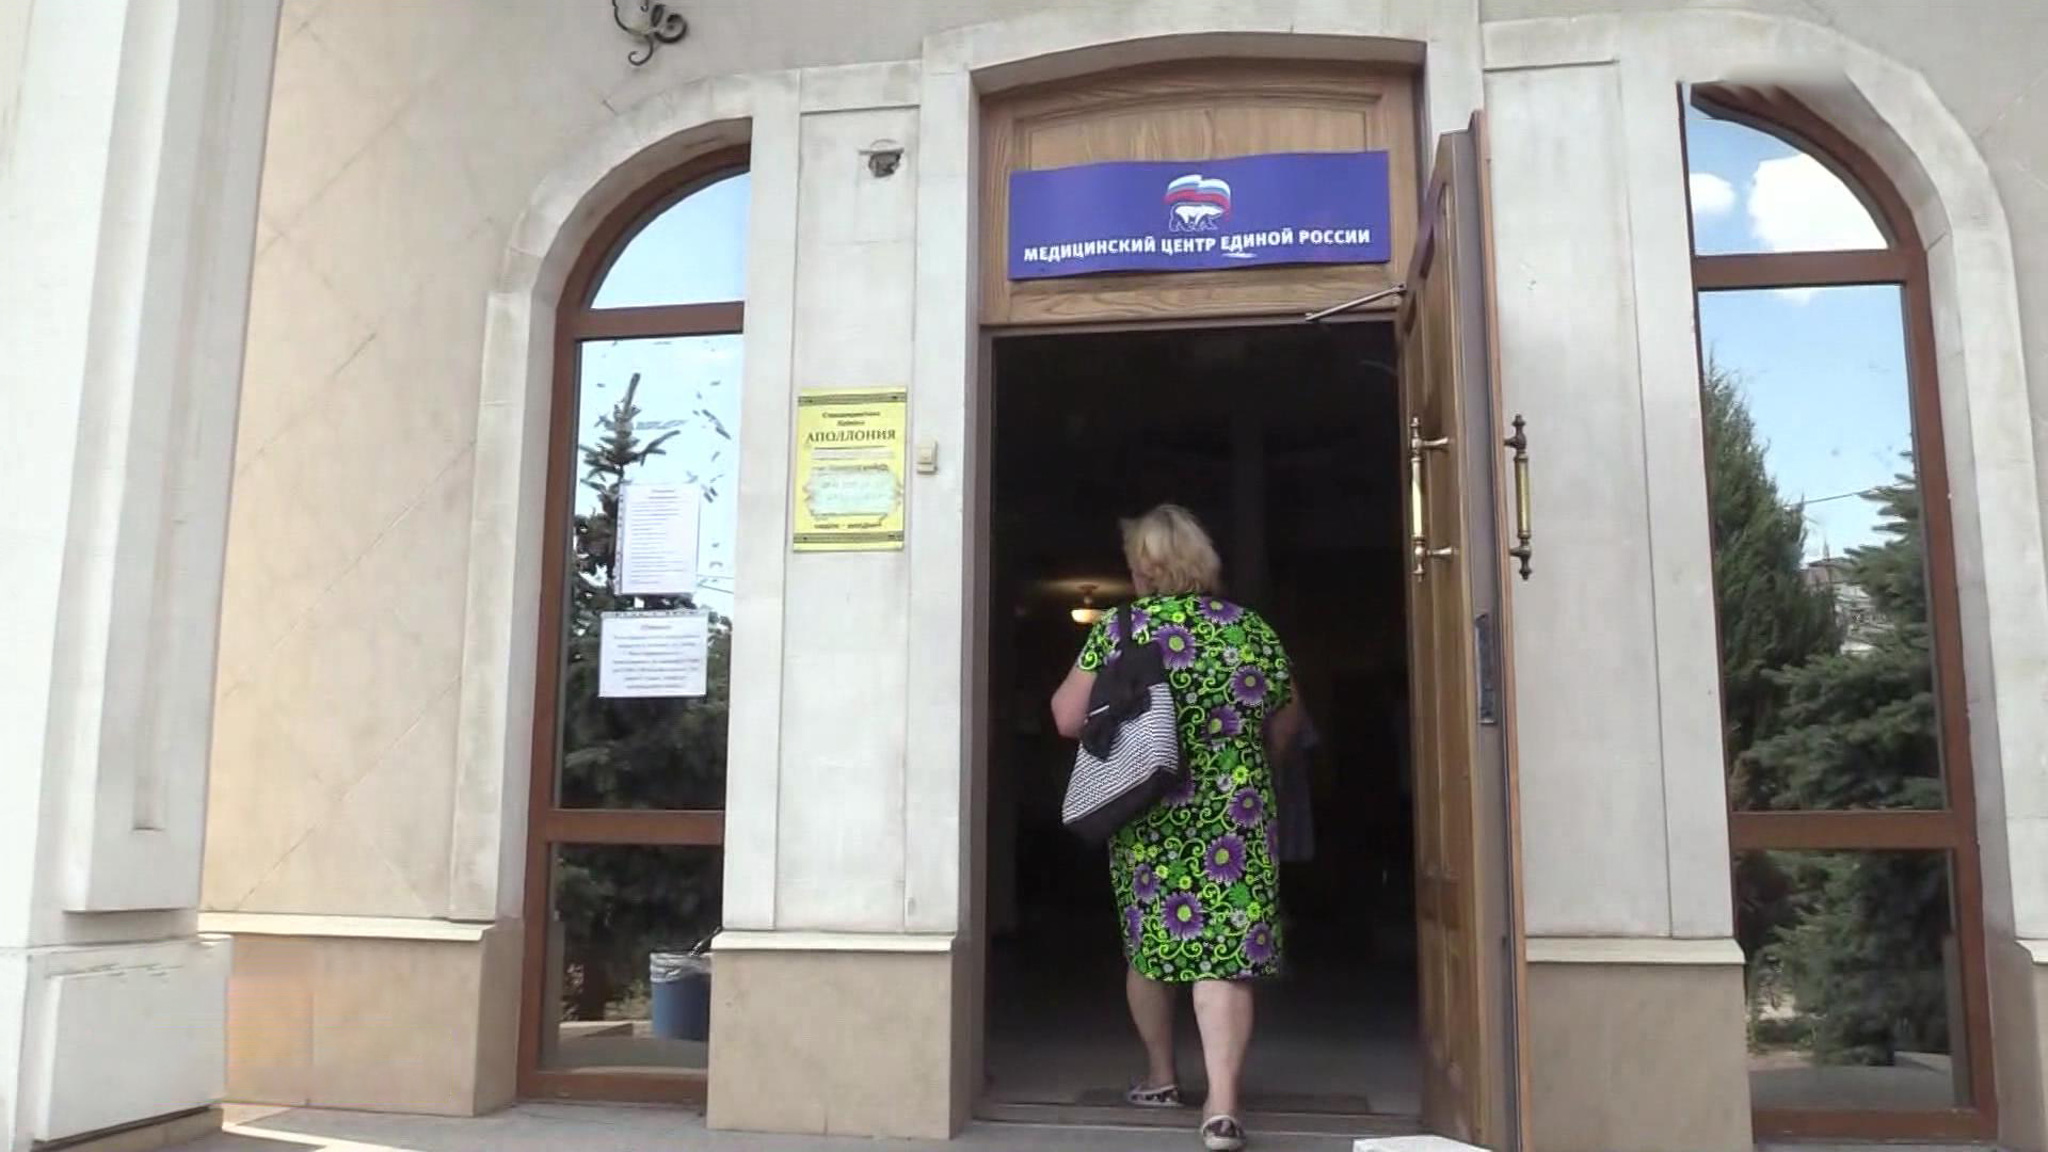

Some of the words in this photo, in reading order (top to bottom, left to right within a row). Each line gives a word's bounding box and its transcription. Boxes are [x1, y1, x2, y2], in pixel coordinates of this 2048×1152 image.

[1024, 236, 1155, 262] МЕДИЦИНСКИЙ
[1161, 238, 1216, 256] ЦЕНТР
[1220, 228, 1293, 252] ЕДИНОЙ
[1299, 229, 1370, 244] РОССИИ
[807, 429, 896, 442] АПОЛЛОНИЯ
